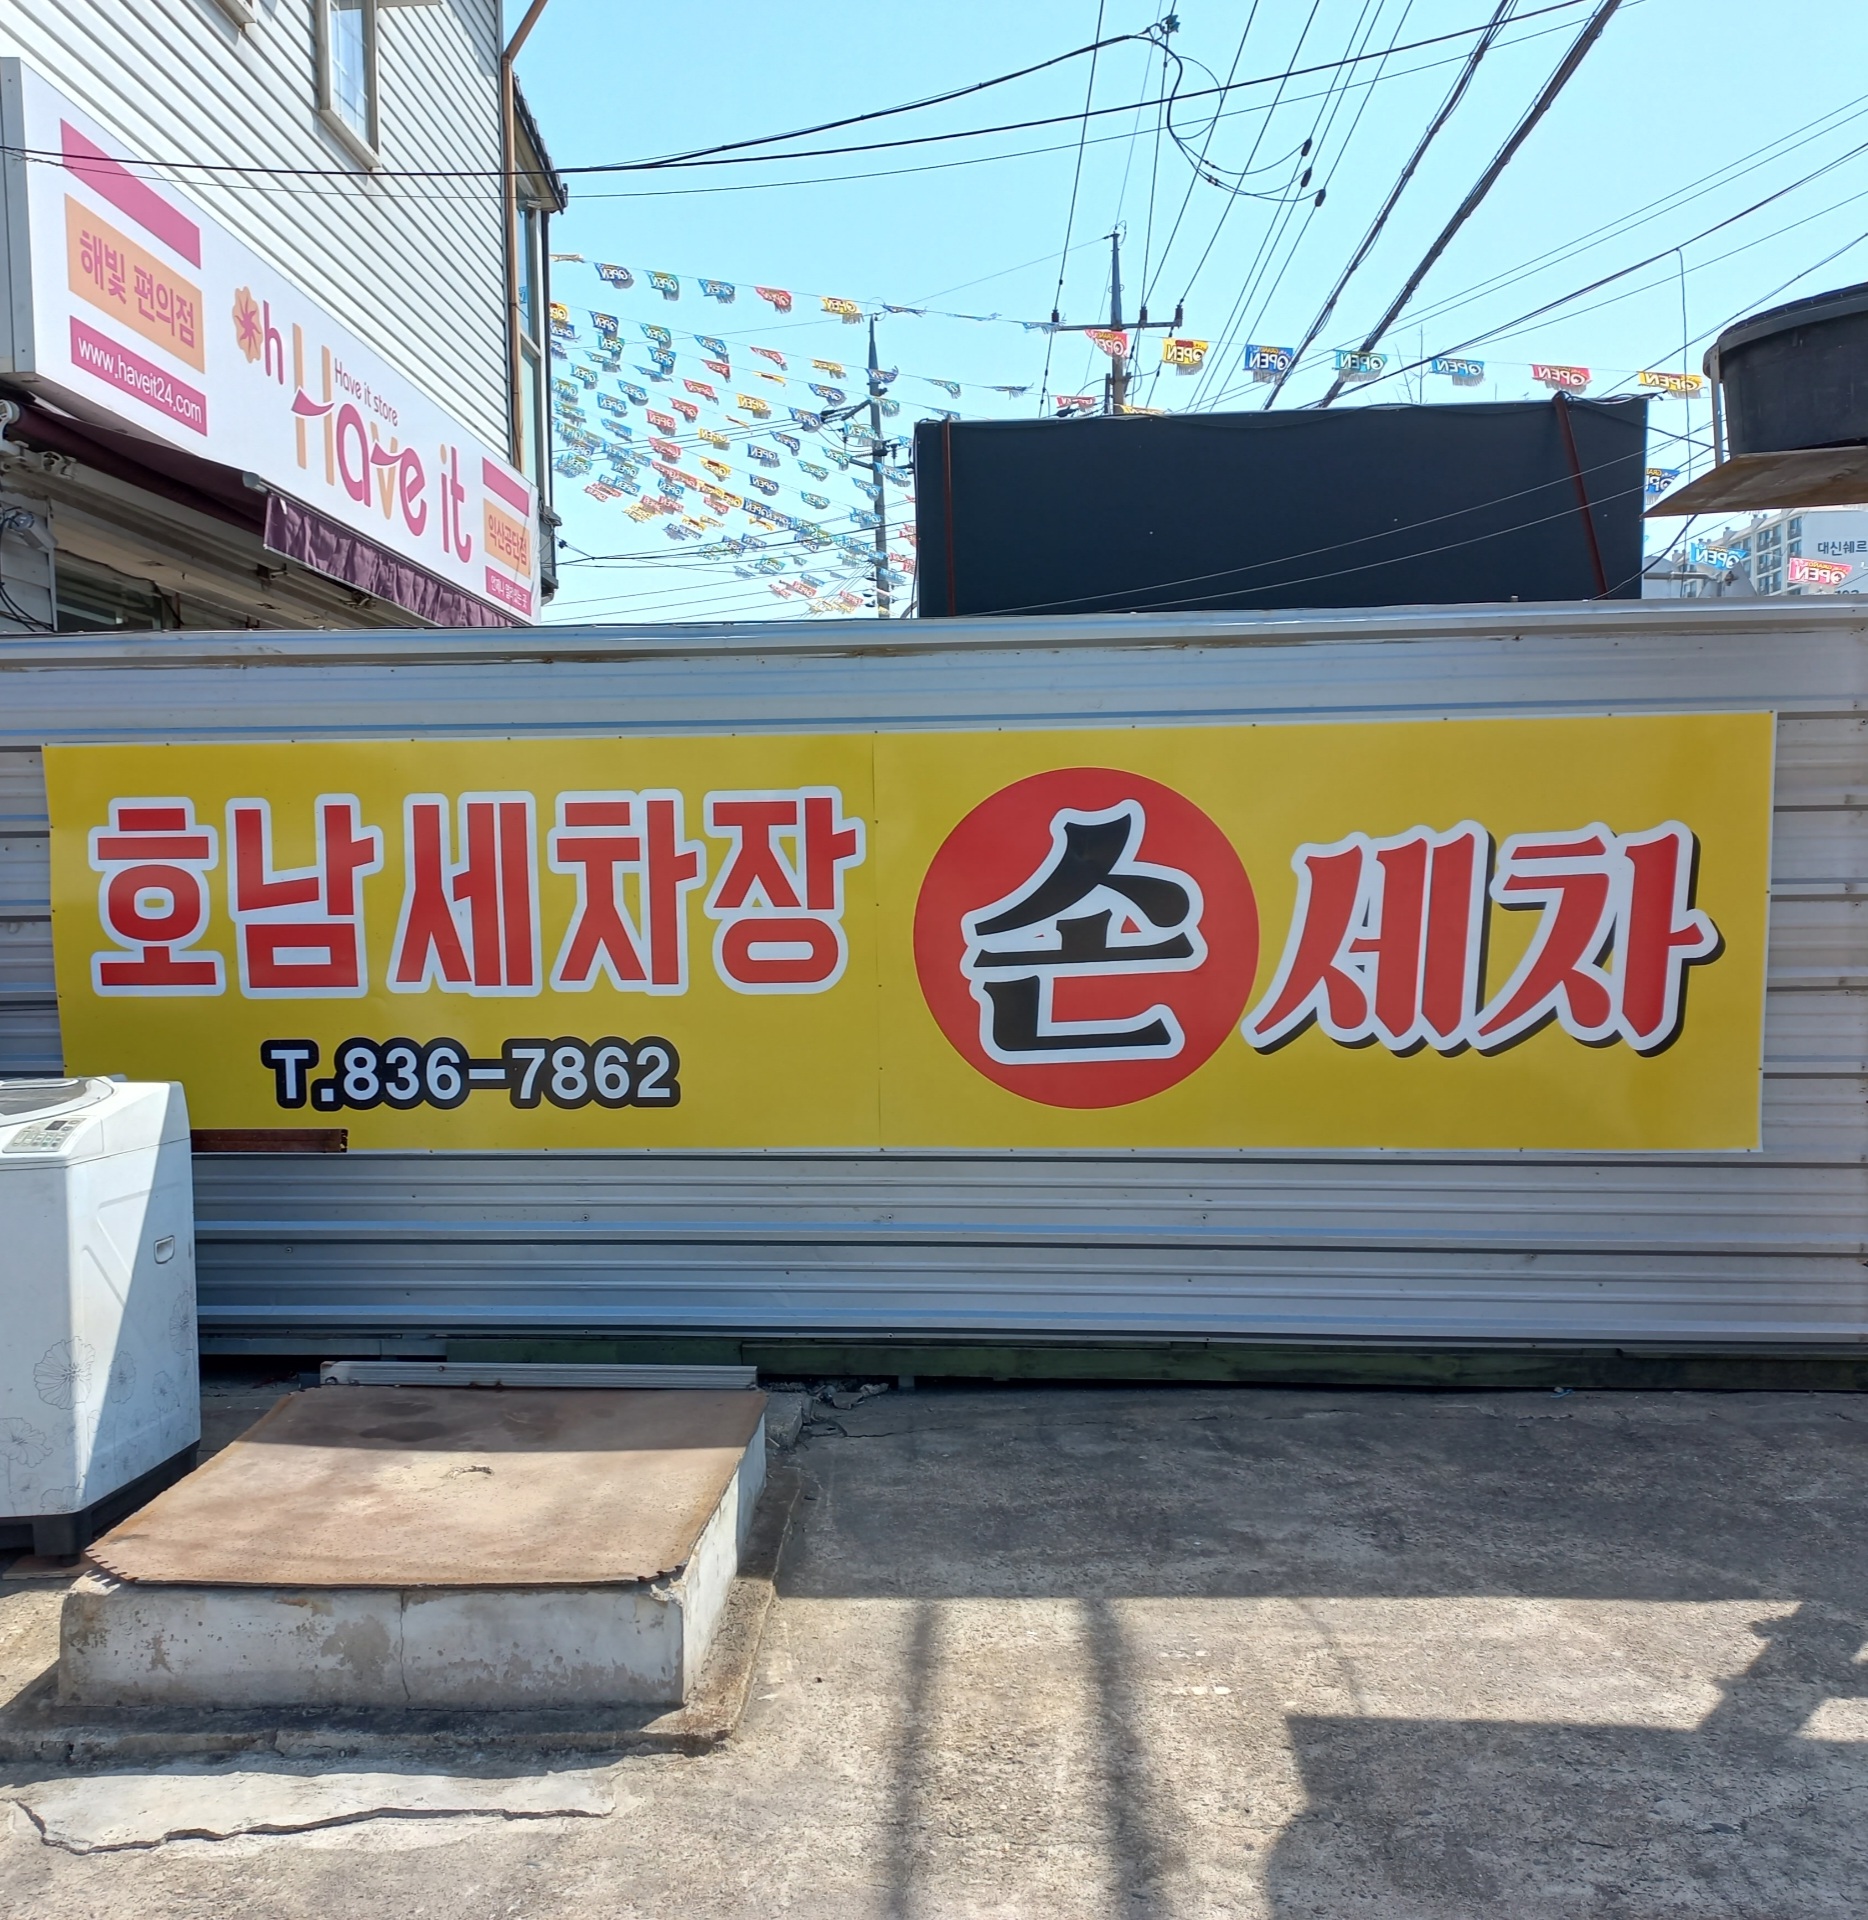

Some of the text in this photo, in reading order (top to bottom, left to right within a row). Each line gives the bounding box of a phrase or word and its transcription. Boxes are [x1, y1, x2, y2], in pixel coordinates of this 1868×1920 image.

[79, 229, 196, 349] 해빛 편의점
[77, 337, 202, 424] www.haveit24.com
[334, 357, 399, 428] Have it store
[290, 322, 473, 563] Have it
[88, 786, 866, 1000] 호남세차장
[959, 799, 1725, 1064] 손 세차
[268, 1043, 675, 1106] T.836-7862
